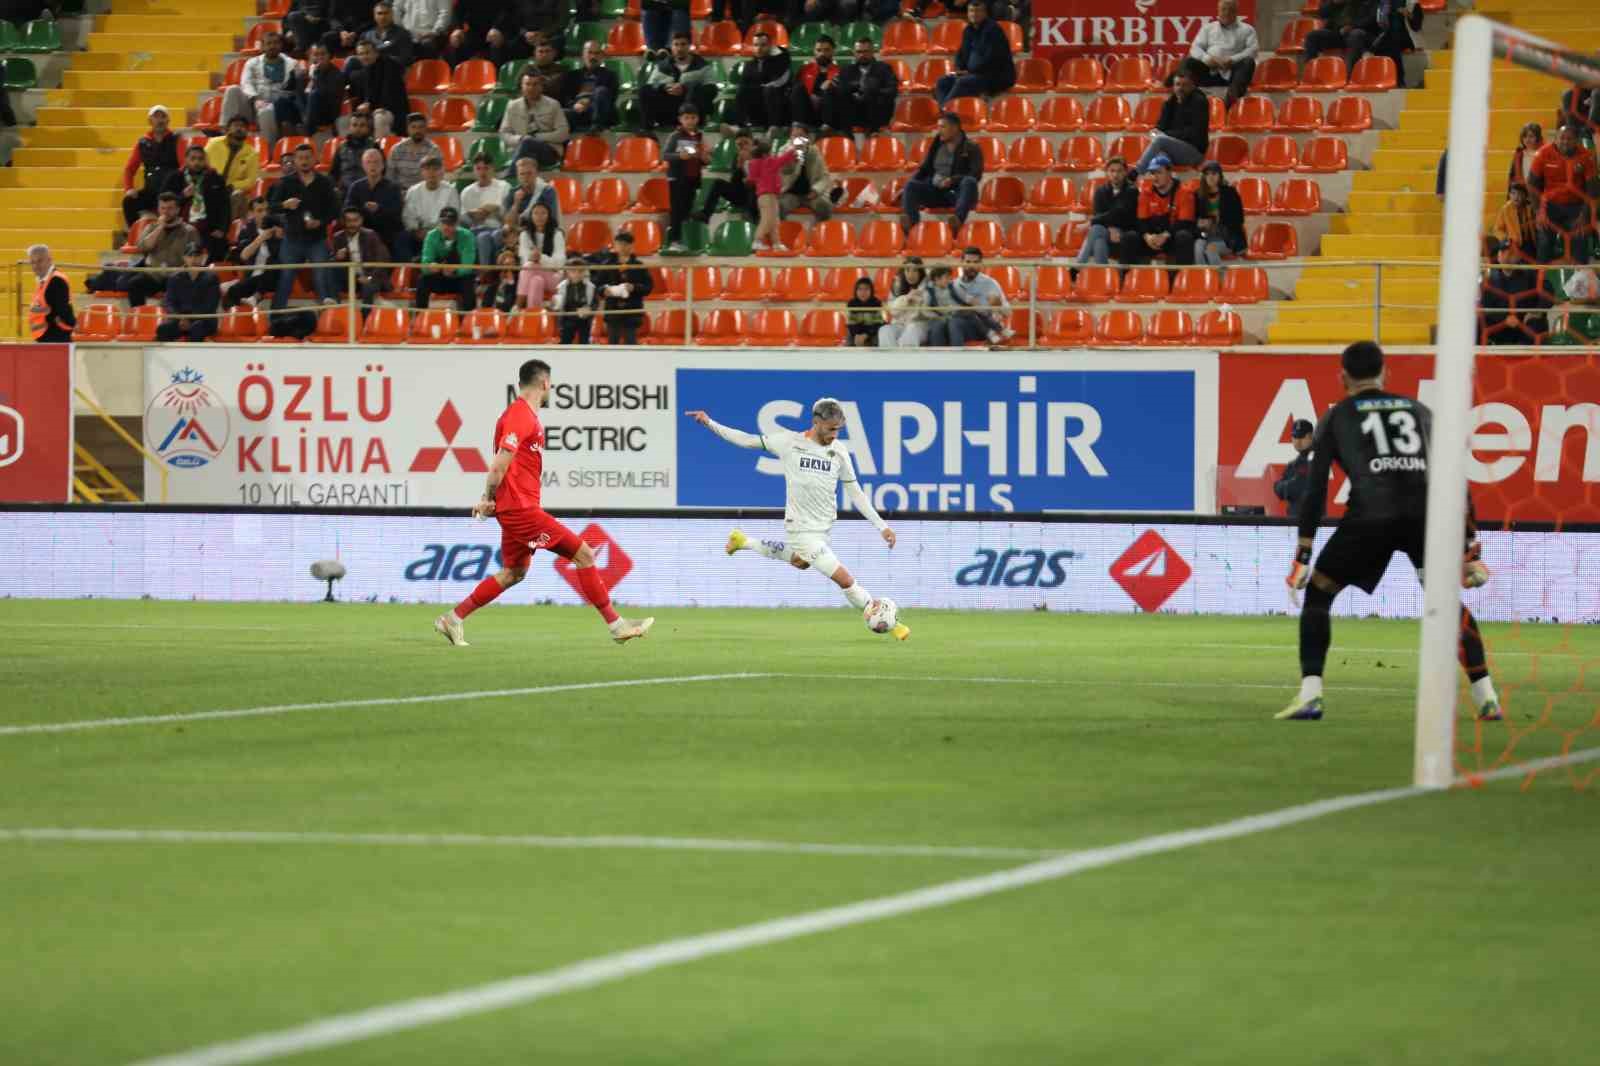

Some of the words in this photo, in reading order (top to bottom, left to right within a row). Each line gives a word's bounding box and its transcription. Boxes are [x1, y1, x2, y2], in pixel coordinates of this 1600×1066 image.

[1037, 15, 1248, 46] KIRBIY
[237, 363, 392, 423] ÖZLÜ
[507, 384, 669, 410] SUBISHI
[544, 425, 648, 452] ECTRIC
[1361, 410, 1422, 455] 13
[237, 427, 392, 474] KLİMA
[567, 465, 670, 488] SİSTEMLERİ
[800, 457, 831, 472] TAV
[1369, 456, 1427, 473] ORKUN
[239, 482, 262, 505] 10
[268, 482, 300, 506] YIL
[307, 480, 408, 505] GARANTİ
[955, 546, 1075, 588] aras
